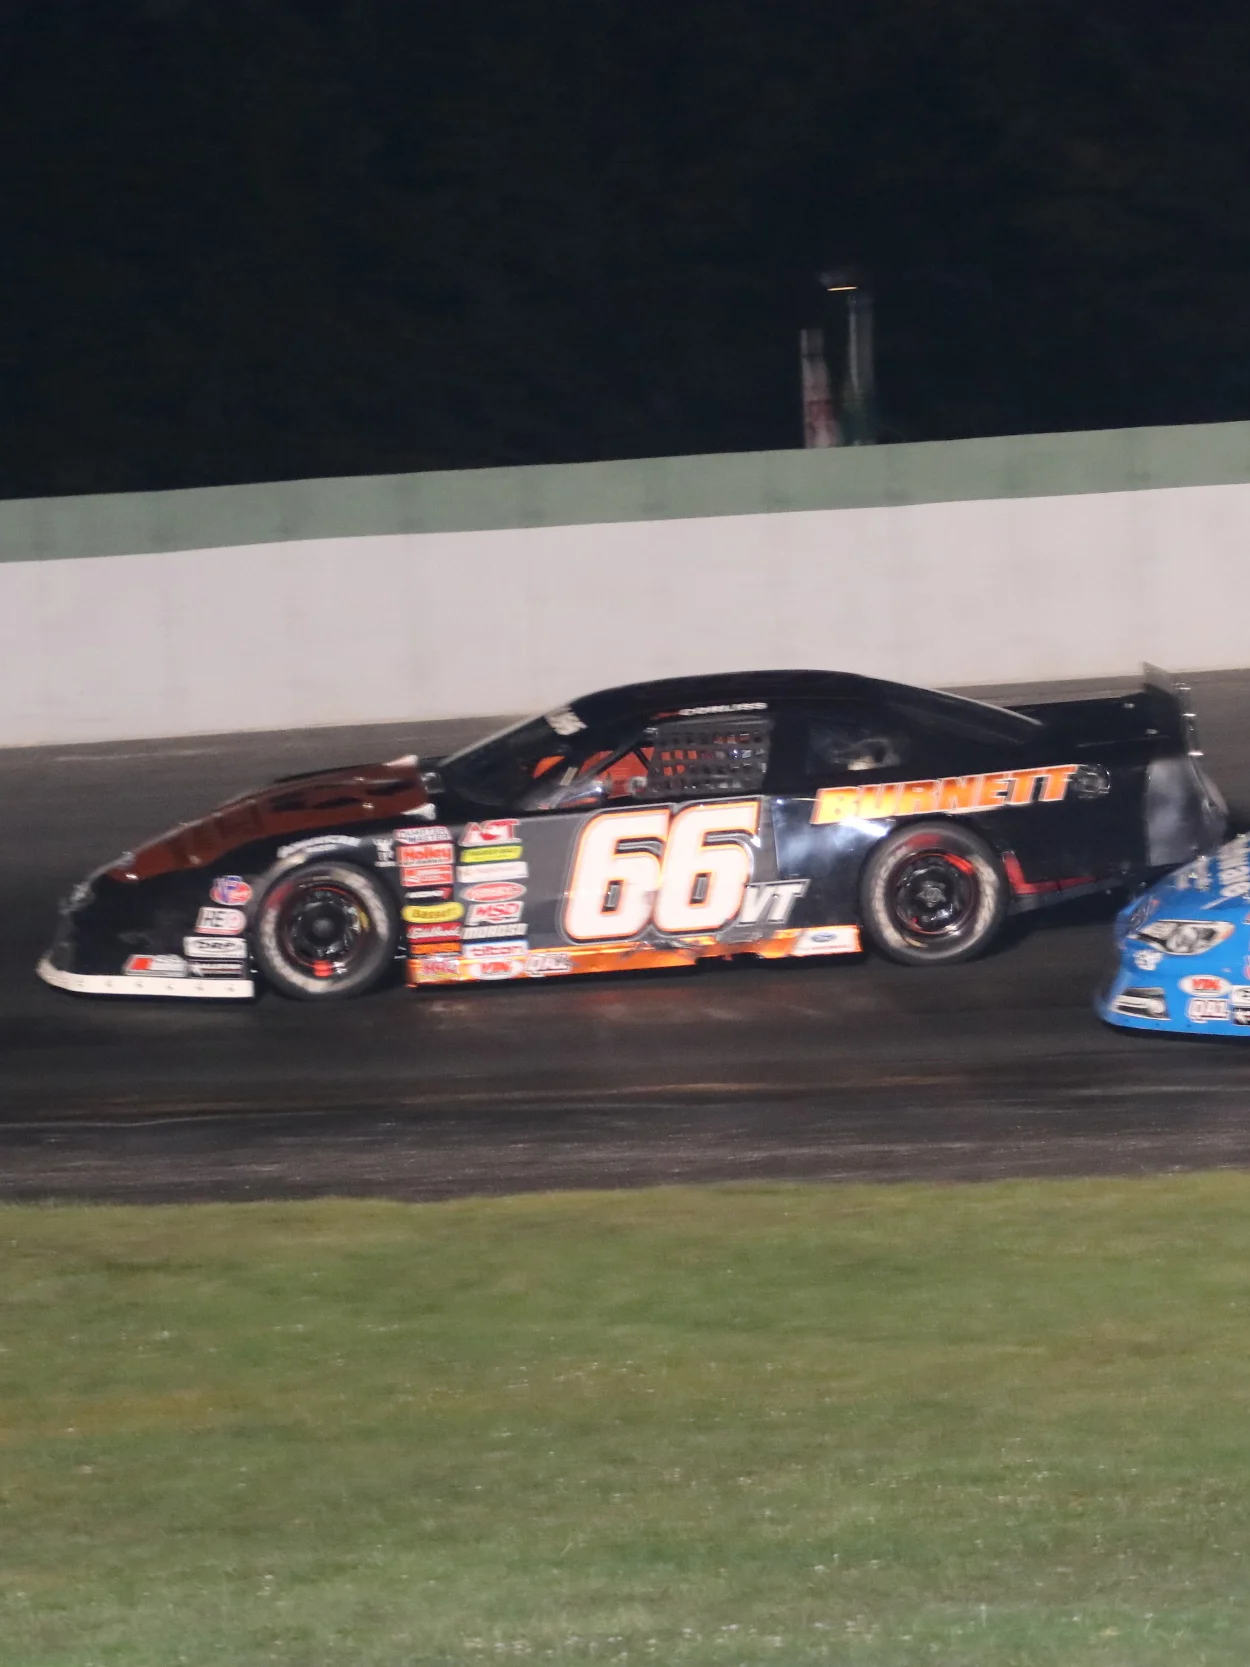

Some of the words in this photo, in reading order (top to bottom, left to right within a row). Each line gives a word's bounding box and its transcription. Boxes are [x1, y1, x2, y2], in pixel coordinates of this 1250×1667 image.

[811, 764, 1081, 824] BURNETT
[560, 798, 763, 943] 66
[736, 879, 811, 925] VT
